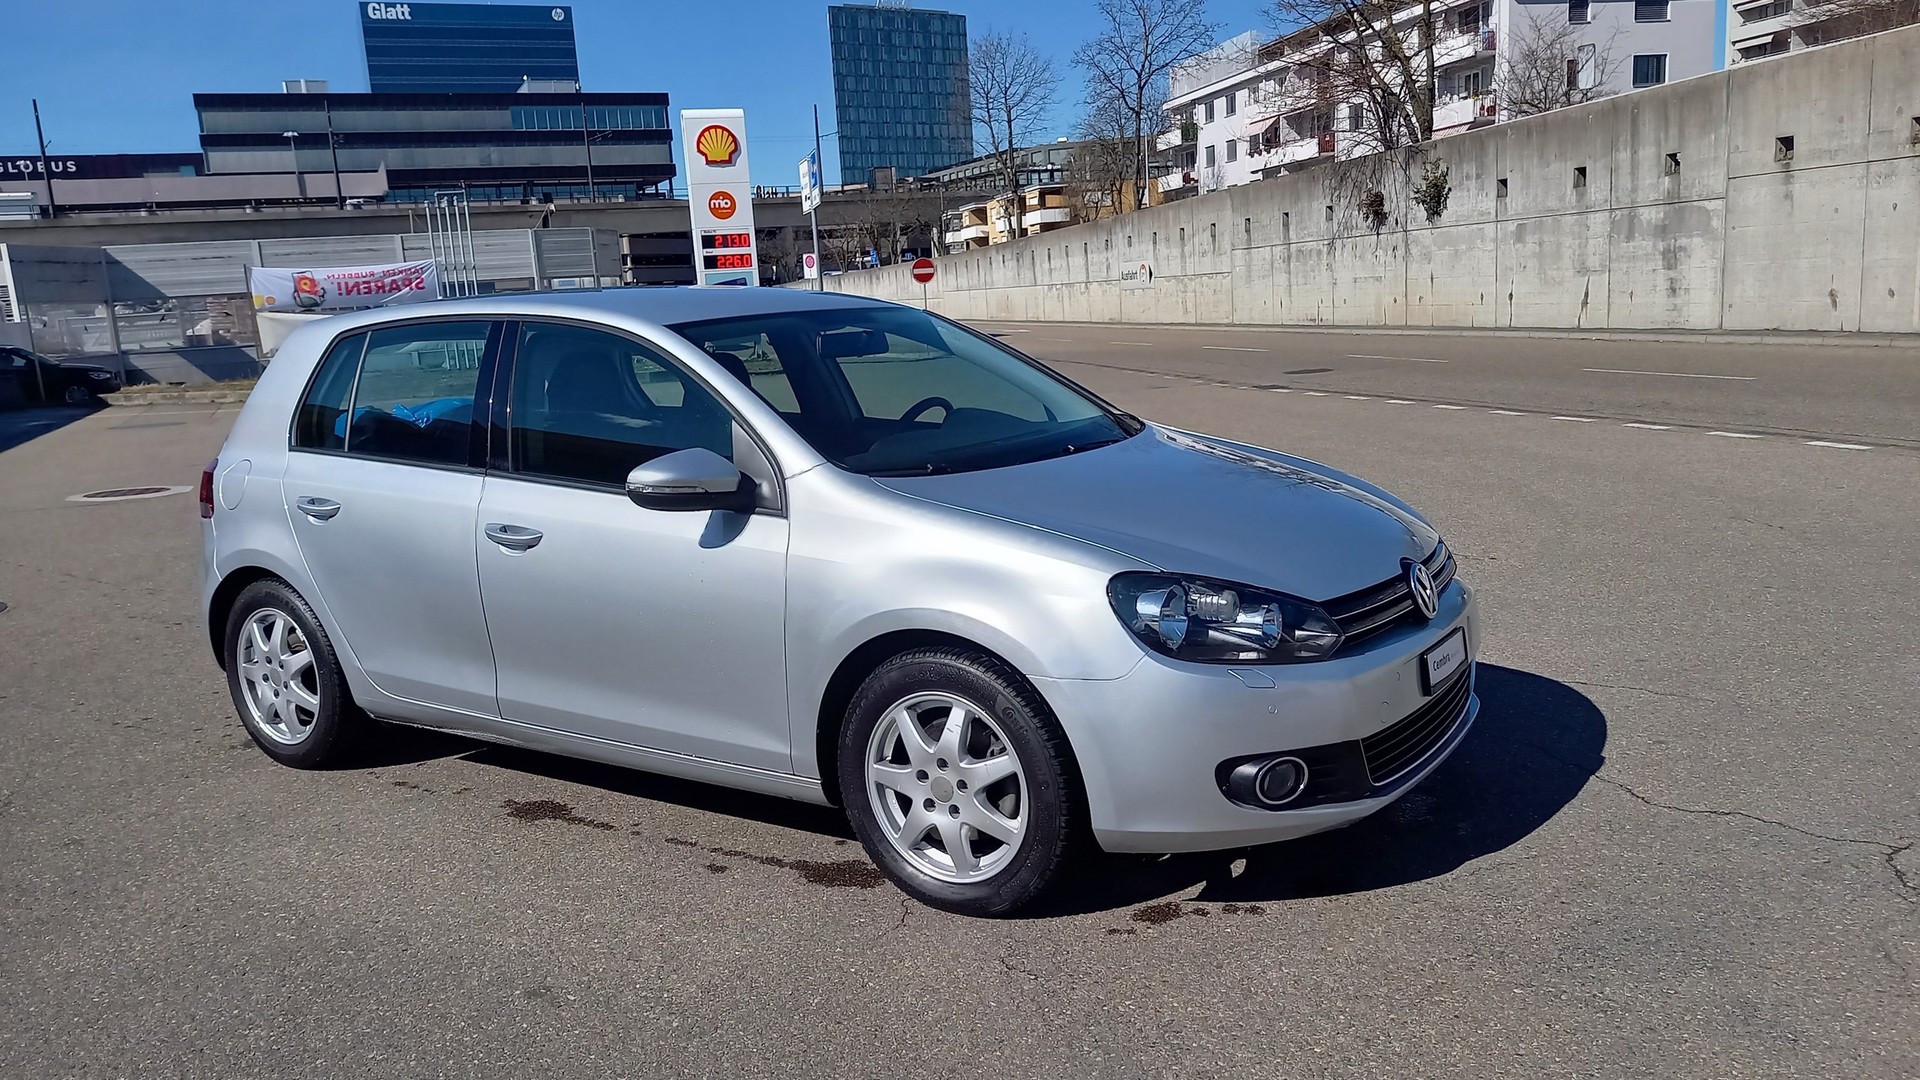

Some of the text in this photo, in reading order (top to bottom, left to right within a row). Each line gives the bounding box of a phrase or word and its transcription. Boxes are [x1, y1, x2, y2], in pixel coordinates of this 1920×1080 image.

[367, 2, 412, 20] Glatt
[552, 8, 564, 21] hp
[710, 195, 731, 209] mio
